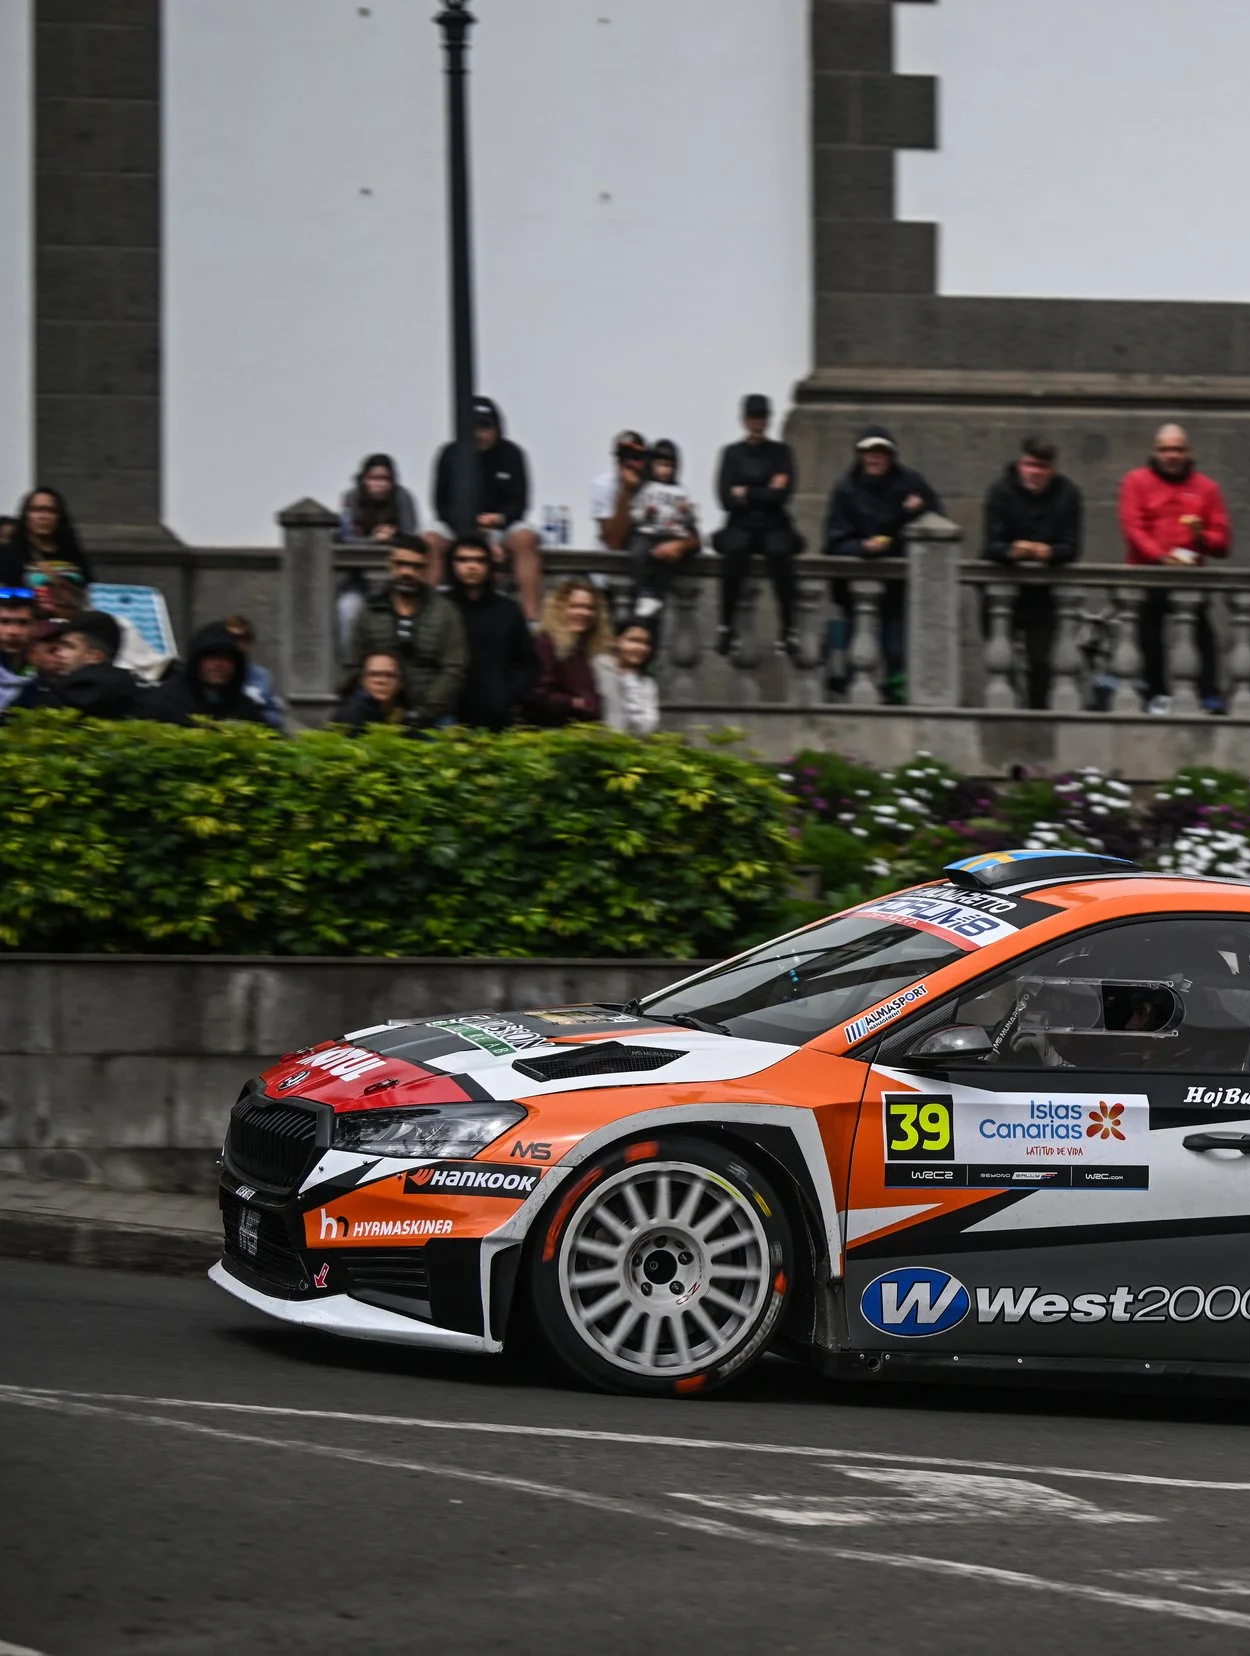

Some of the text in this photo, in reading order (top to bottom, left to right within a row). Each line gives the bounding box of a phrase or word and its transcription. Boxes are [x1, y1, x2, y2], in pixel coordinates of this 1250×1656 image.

[865, 984, 929, 1024] ALMASPORT
[1030, 1100, 1083, 1120] Islas
[890, 1103, 951, 1152] 39
[979, 1118, 1083, 1141] Canarias
[510, 1141, 553, 1161] MS
[1057, 1147, 1066, 1155] DE
[1067, 1147, 1084, 1156] VIDA
[352, 1219, 453, 1237] HYRMASKINER
